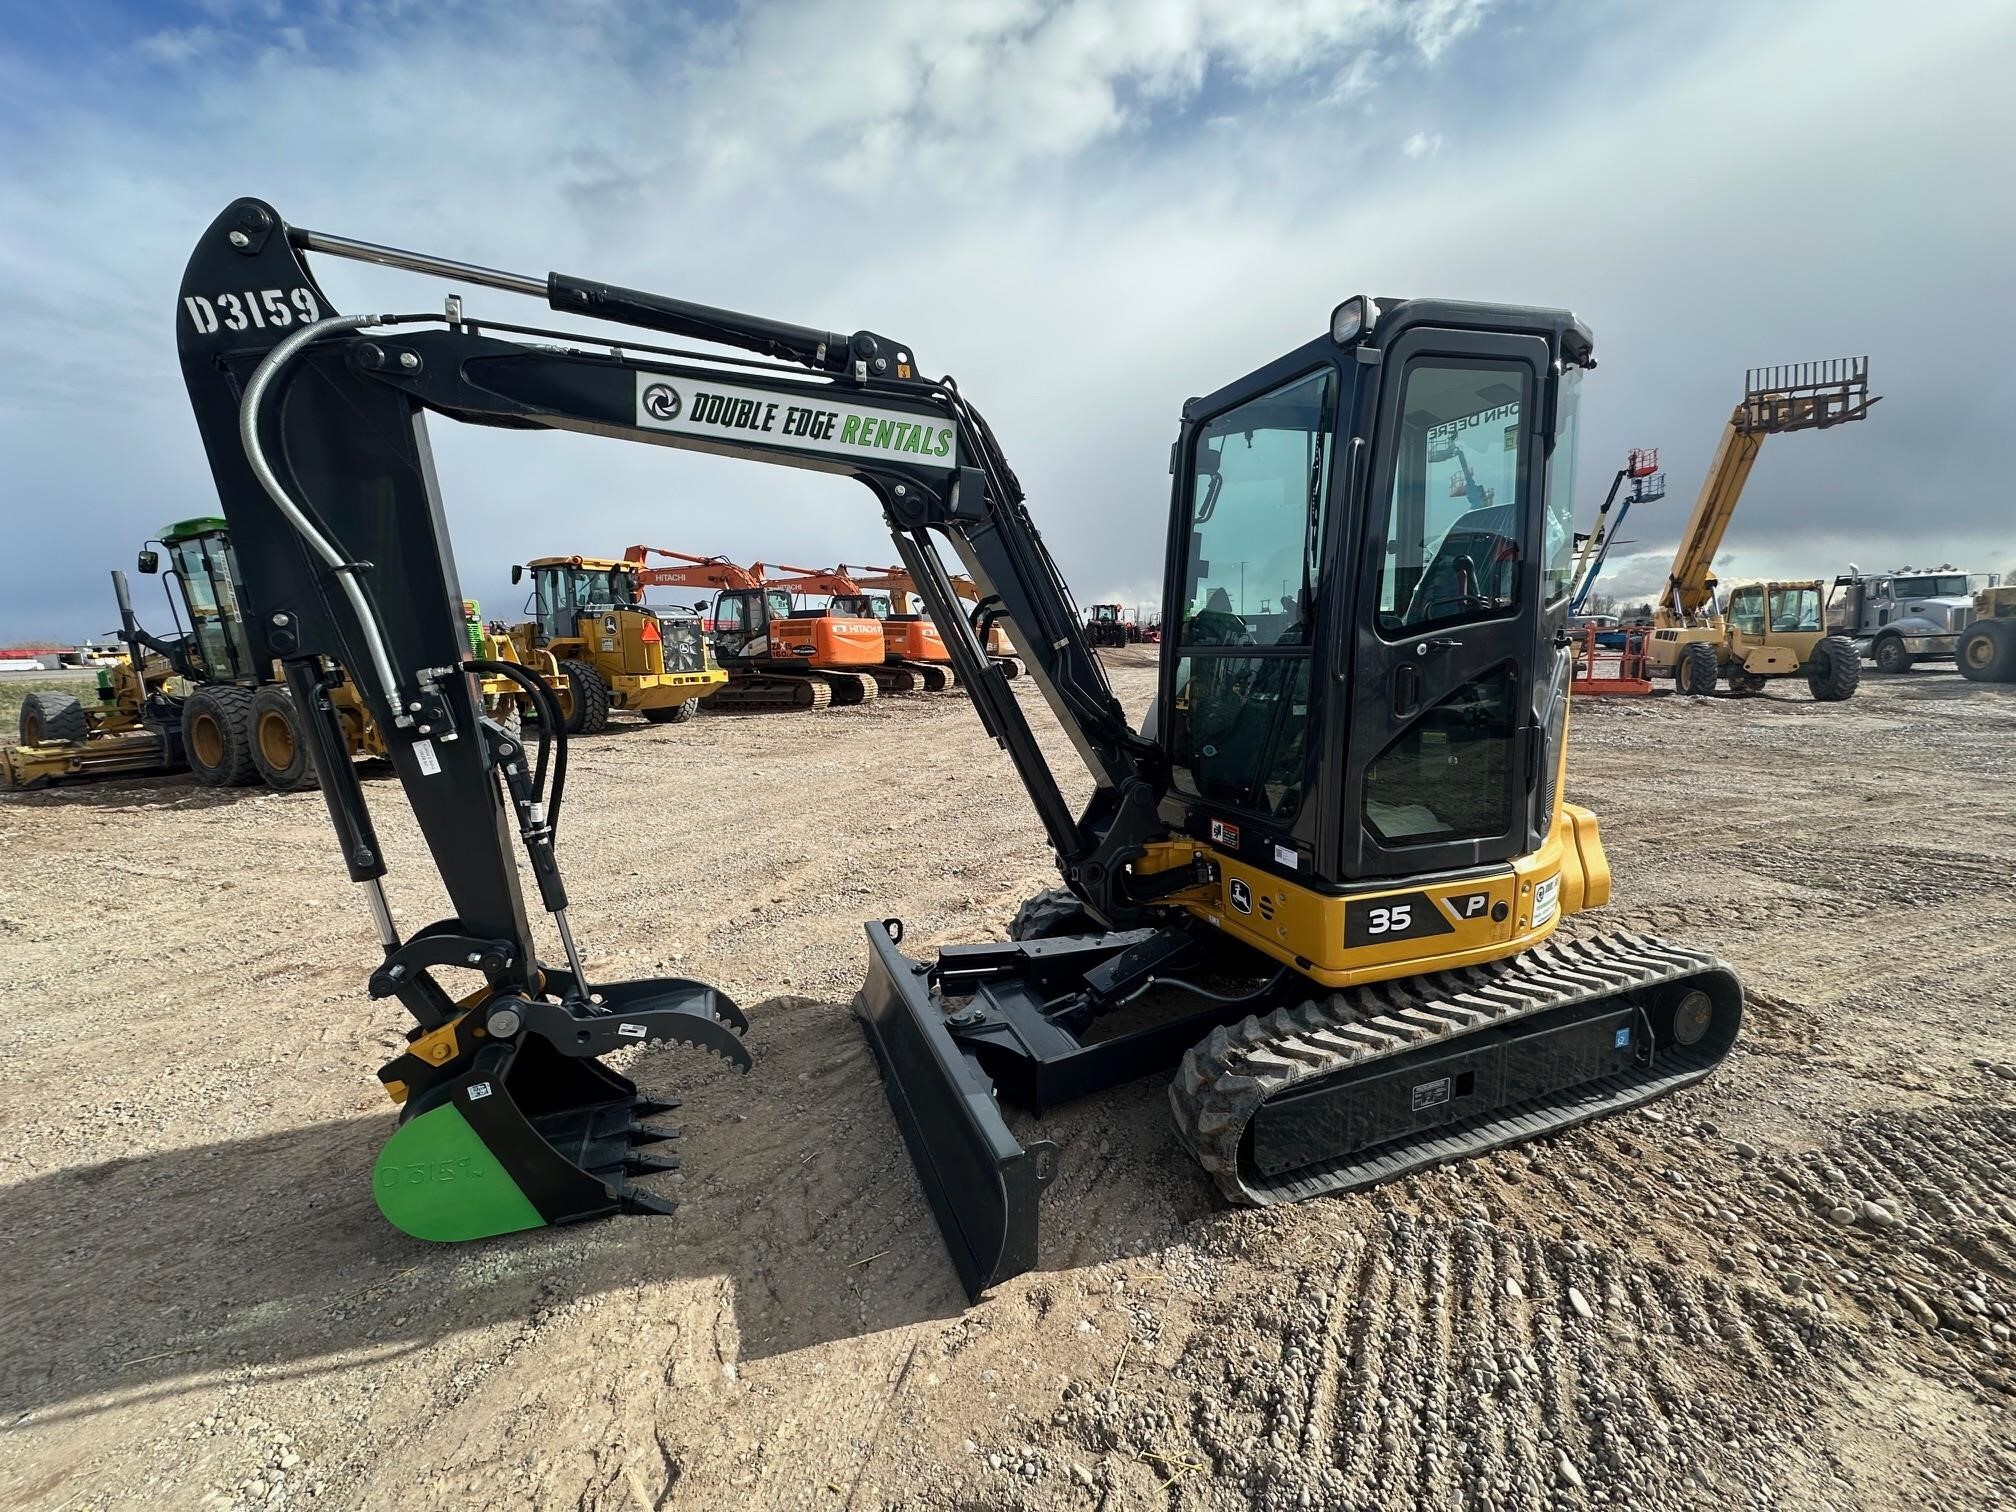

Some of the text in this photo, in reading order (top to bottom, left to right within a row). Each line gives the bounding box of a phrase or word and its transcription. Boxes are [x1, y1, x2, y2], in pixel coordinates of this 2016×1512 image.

[184, 288, 320, 334] D3159
[689, 392, 953, 457] DOUBLE EDGE RENTALS
[655, 574, 686, 582] HITACHI
[1368, 904, 1412, 935] 35
[1465, 895, 1486, 917] P
